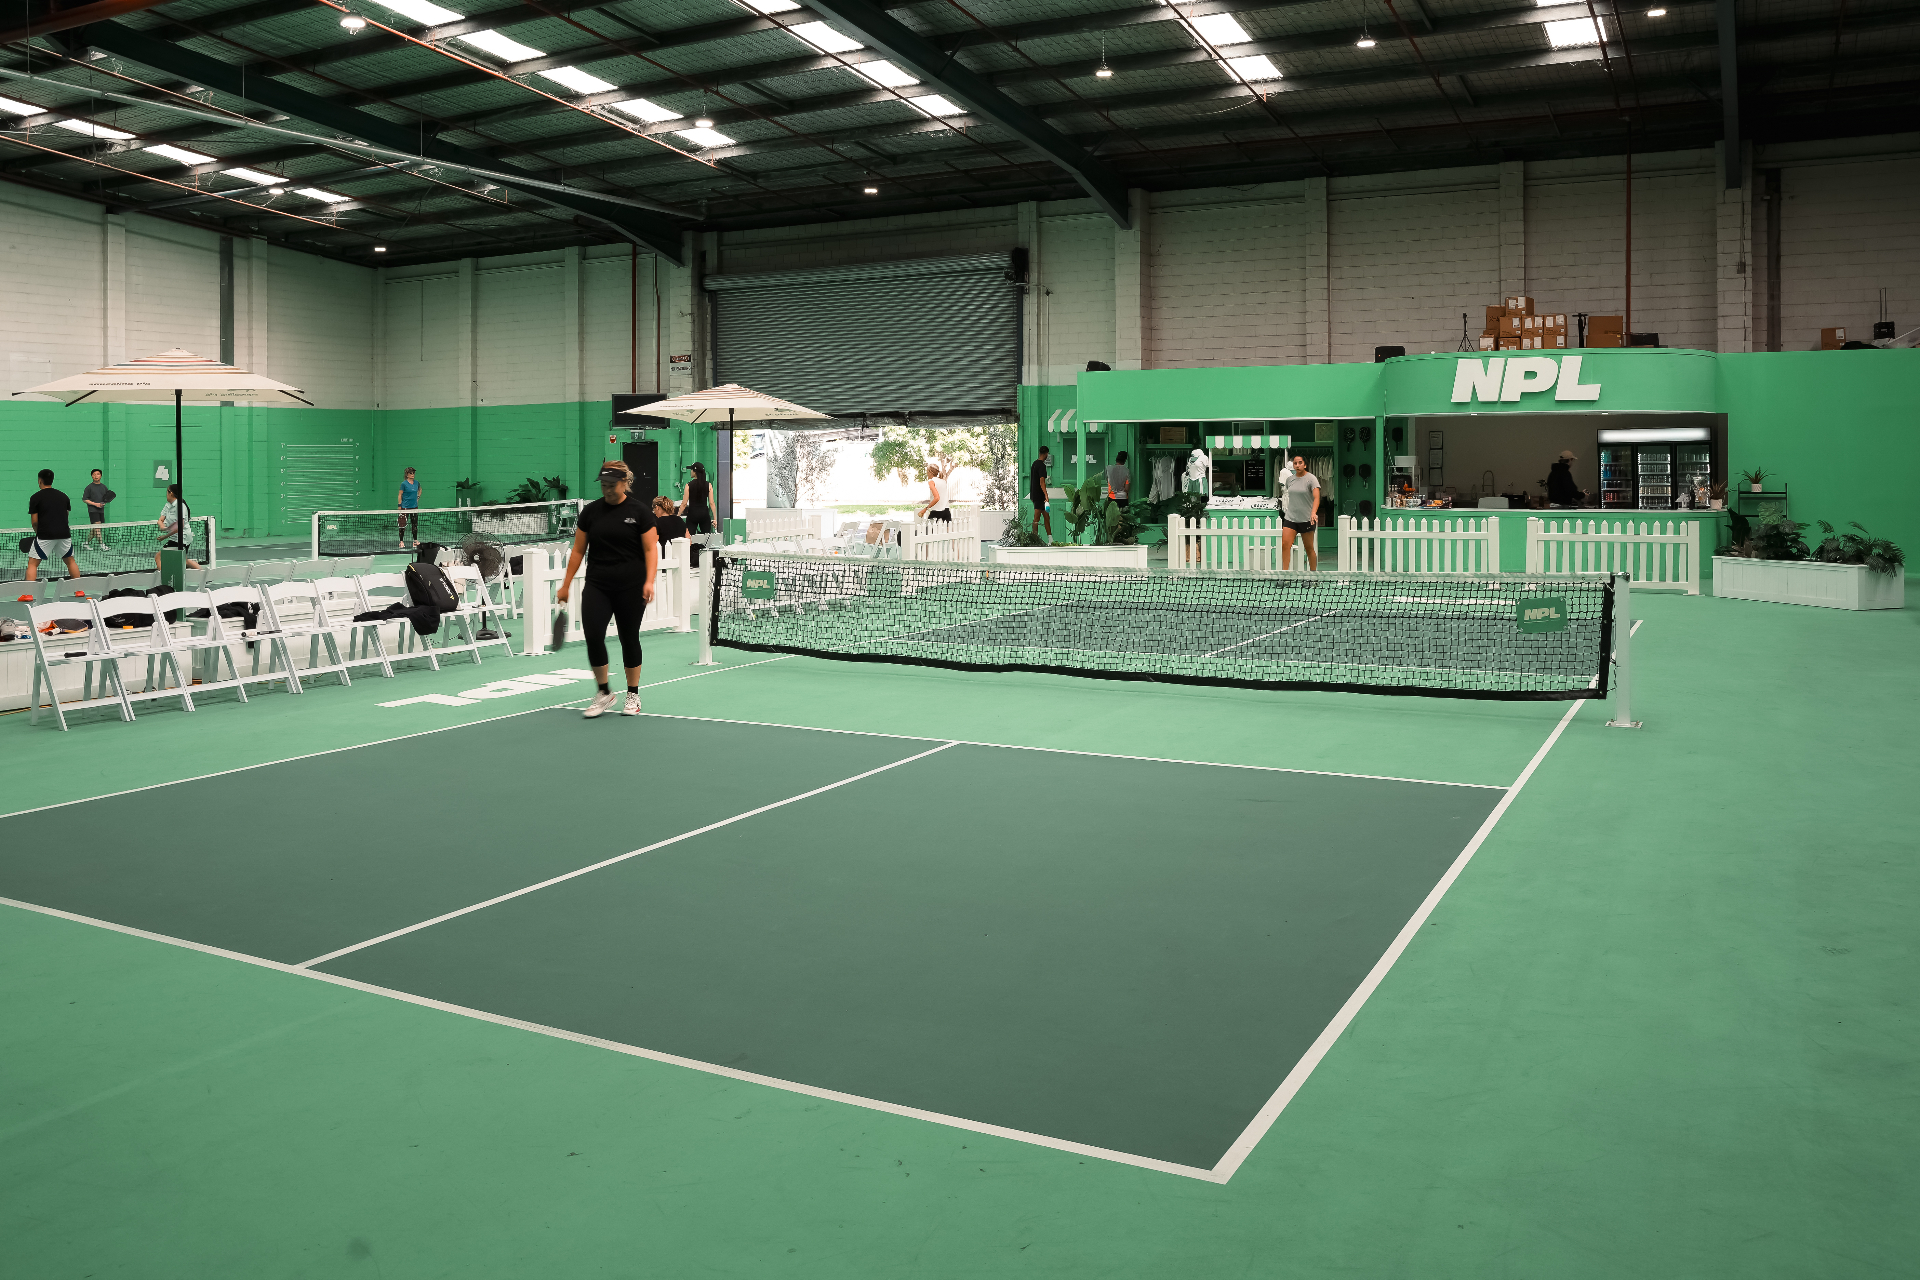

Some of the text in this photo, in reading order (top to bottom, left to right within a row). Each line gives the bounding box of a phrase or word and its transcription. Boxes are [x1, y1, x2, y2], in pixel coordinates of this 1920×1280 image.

[1450, 355, 1602, 403] NPL
[155, 465, 170, 481] 4
[746, 579, 770, 588] NPL
[1523, 607, 1561, 621] NPL
[374, 667, 617, 708] NPL
